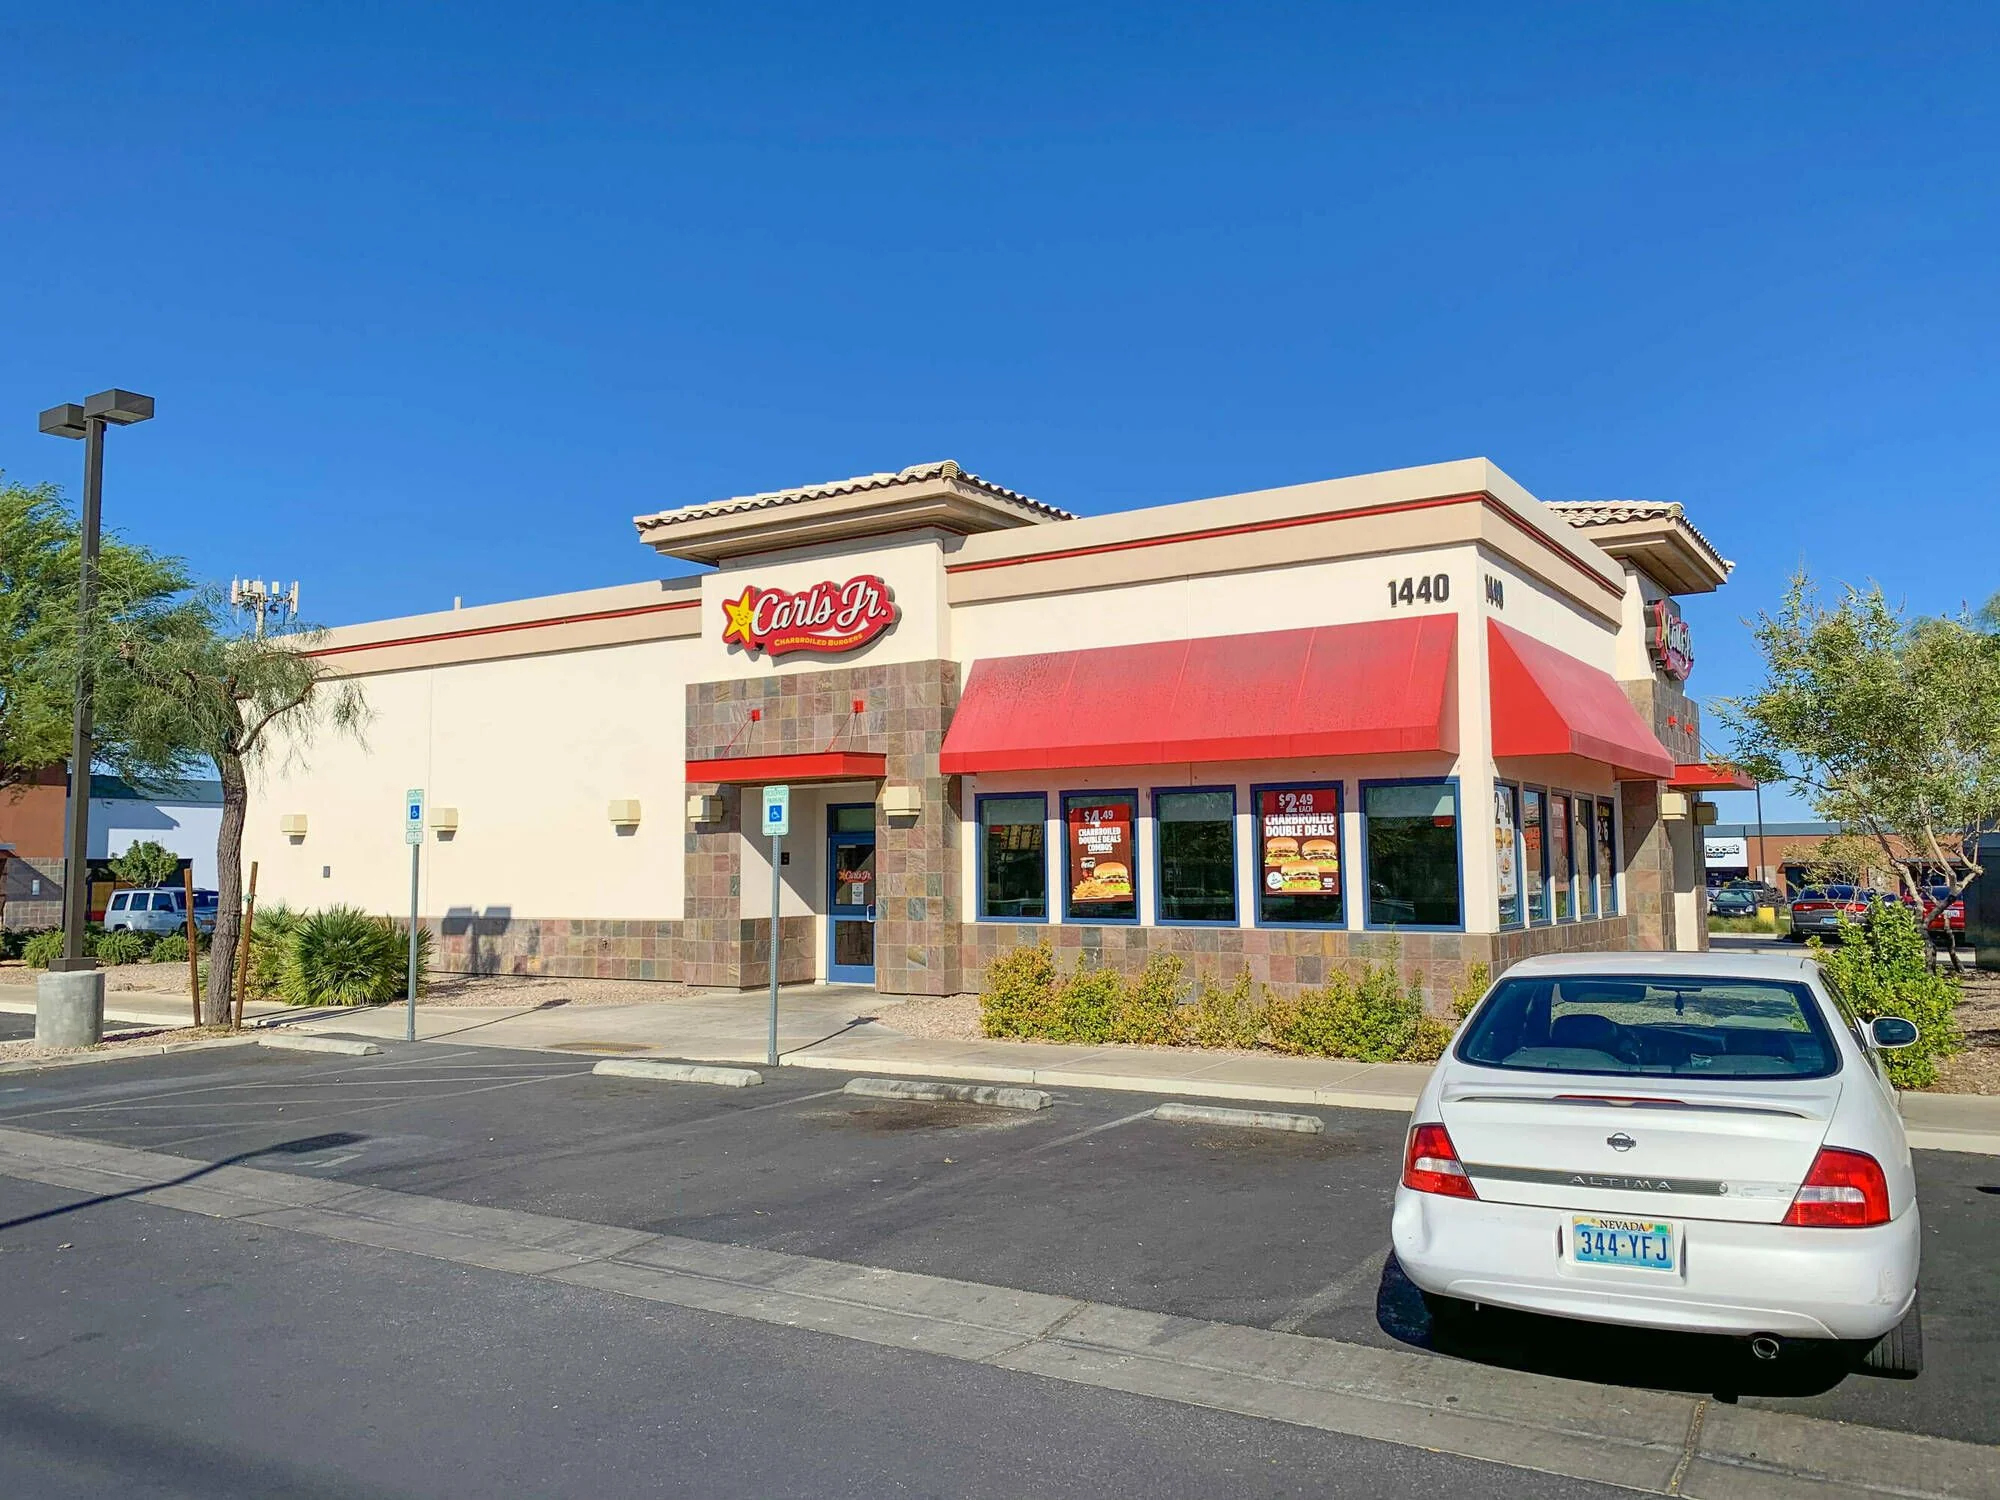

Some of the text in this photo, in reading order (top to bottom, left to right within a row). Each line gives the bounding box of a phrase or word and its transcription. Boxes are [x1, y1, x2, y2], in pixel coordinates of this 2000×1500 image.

[1387, 574, 1450, 608] 1440
[751, 580, 888, 636] Carl's Jr.
[774, 633, 863, 647] CHARBROILED BURGERS
[1279, 793, 1313, 813] $2.49
[1084, 809, 1114, 828] $4.49
[1265, 812, 1335, 826] CHARBROILED
[1078, 826, 1121, 837] CHARBROILED
[1265, 824, 1335, 837] DOUBLE DEALS
[1102, 835, 1121, 843] DEALS
[1706, 845, 1739, 854] boost
[1569, 1175, 1672, 1191] ALTIMA
[1600, 1219, 1646, 1232] NEVADA
